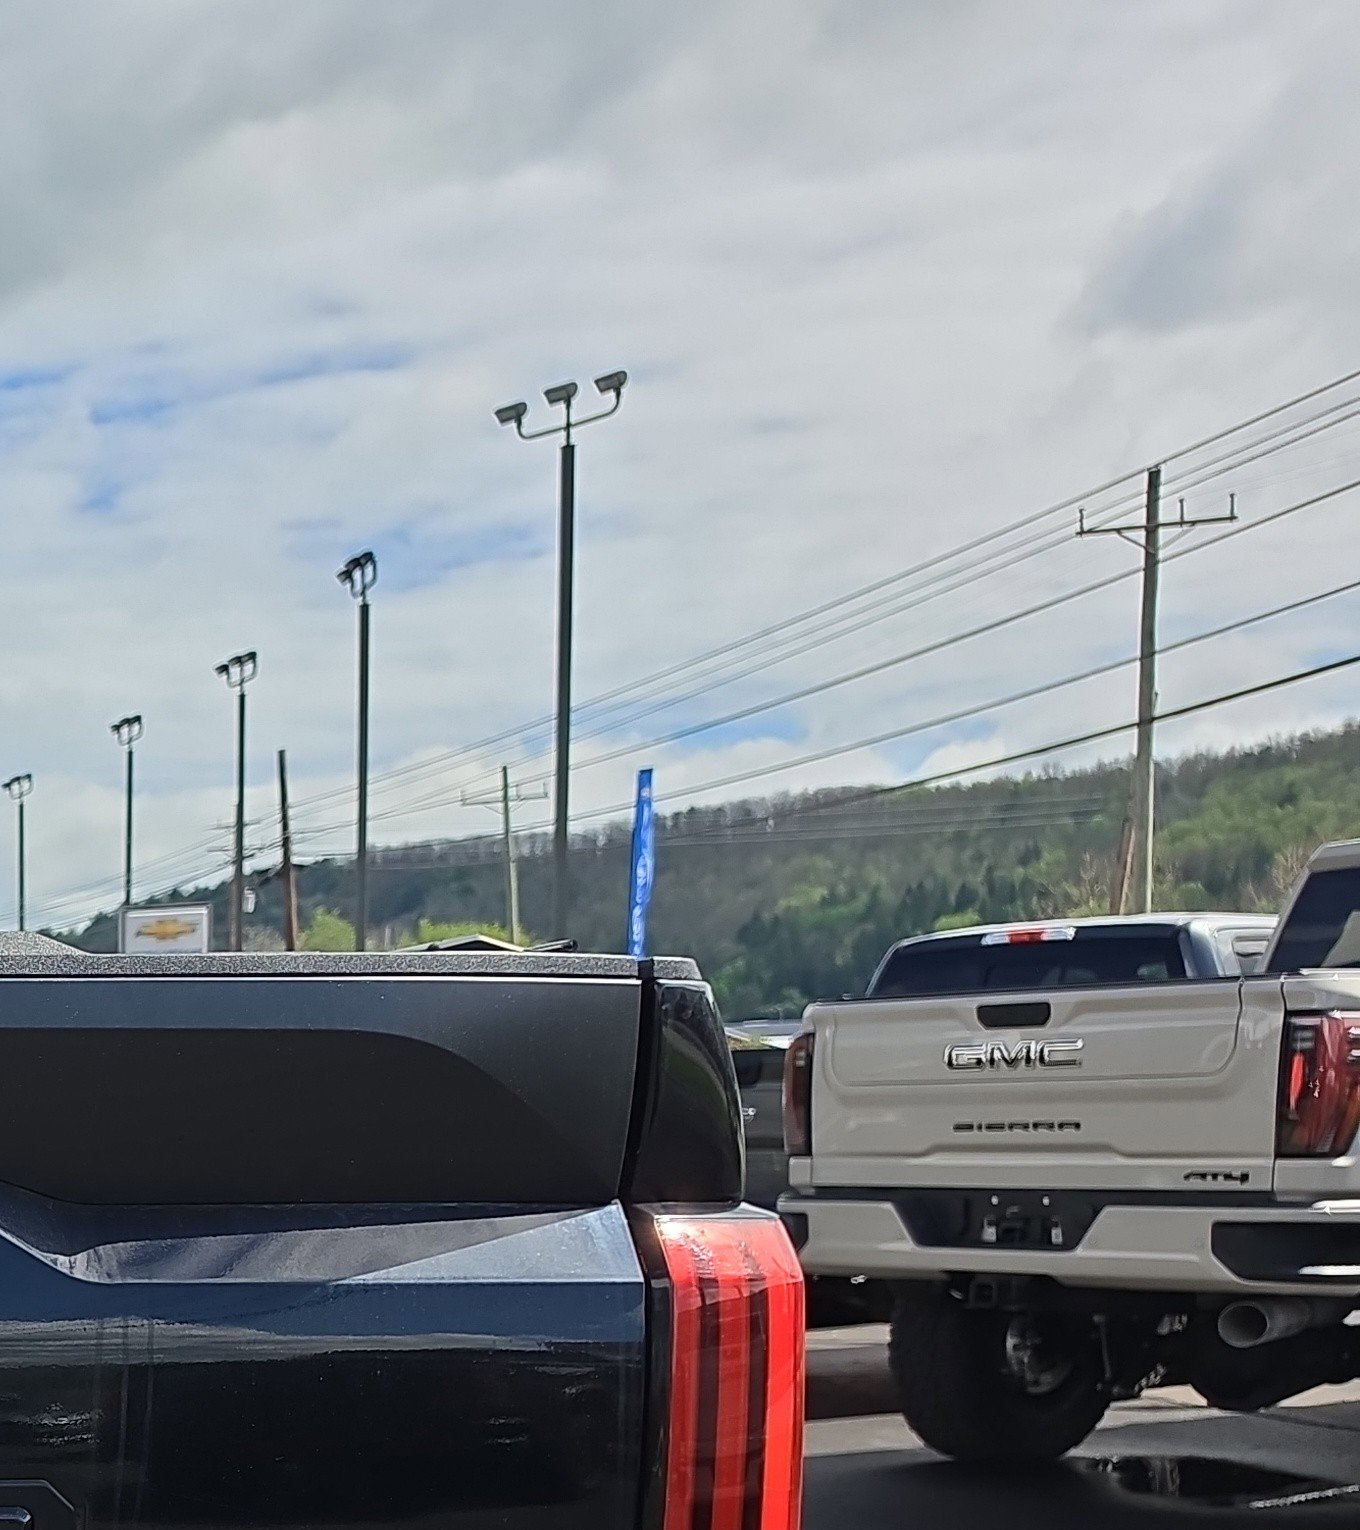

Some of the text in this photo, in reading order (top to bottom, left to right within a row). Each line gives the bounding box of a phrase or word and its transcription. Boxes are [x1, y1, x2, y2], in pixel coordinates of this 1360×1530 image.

[943, 1038, 1084, 1071] GMC
[952, 1120, 1081, 1133] SIERRA
[1183, 1170, 1250, 1185] AT4
